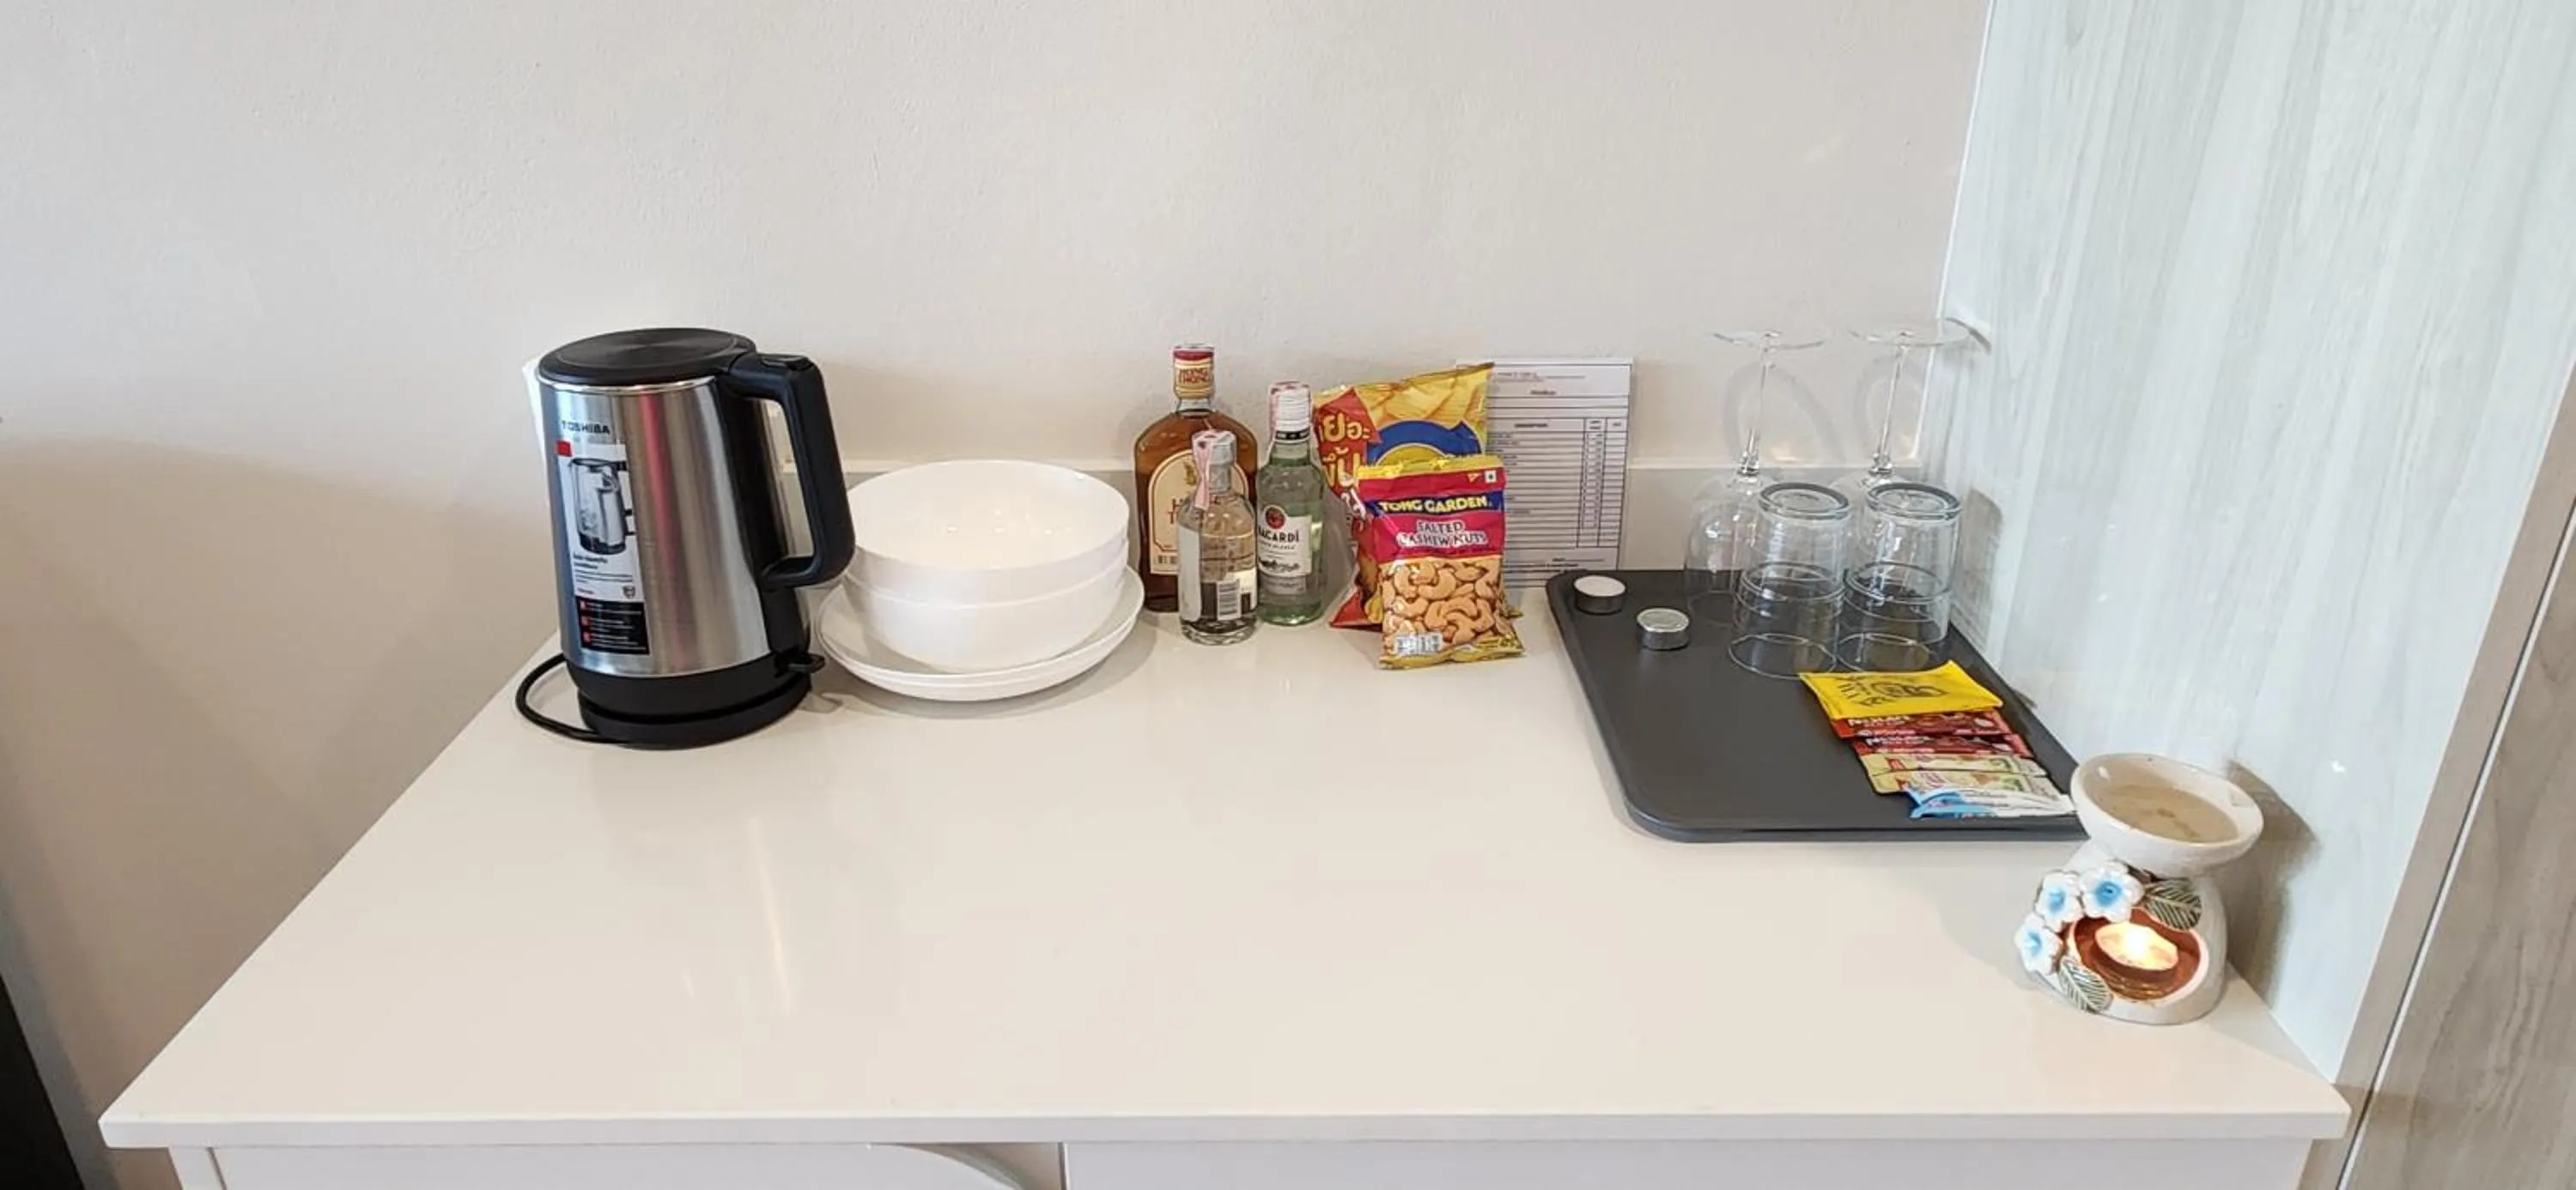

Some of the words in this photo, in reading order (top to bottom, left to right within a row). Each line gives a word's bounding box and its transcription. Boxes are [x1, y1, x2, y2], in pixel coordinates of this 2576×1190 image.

[561, 419, 611, 434] TOSHIBA
[1378, 499, 1423, 512] TONG
[1425, 495, 1488, 513] GARDEN
[1418, 521, 1464, 534] SALTED
[1398, 531, 1449, 546] CASHEW
[1452, 531, 1485, 545] NUTS
